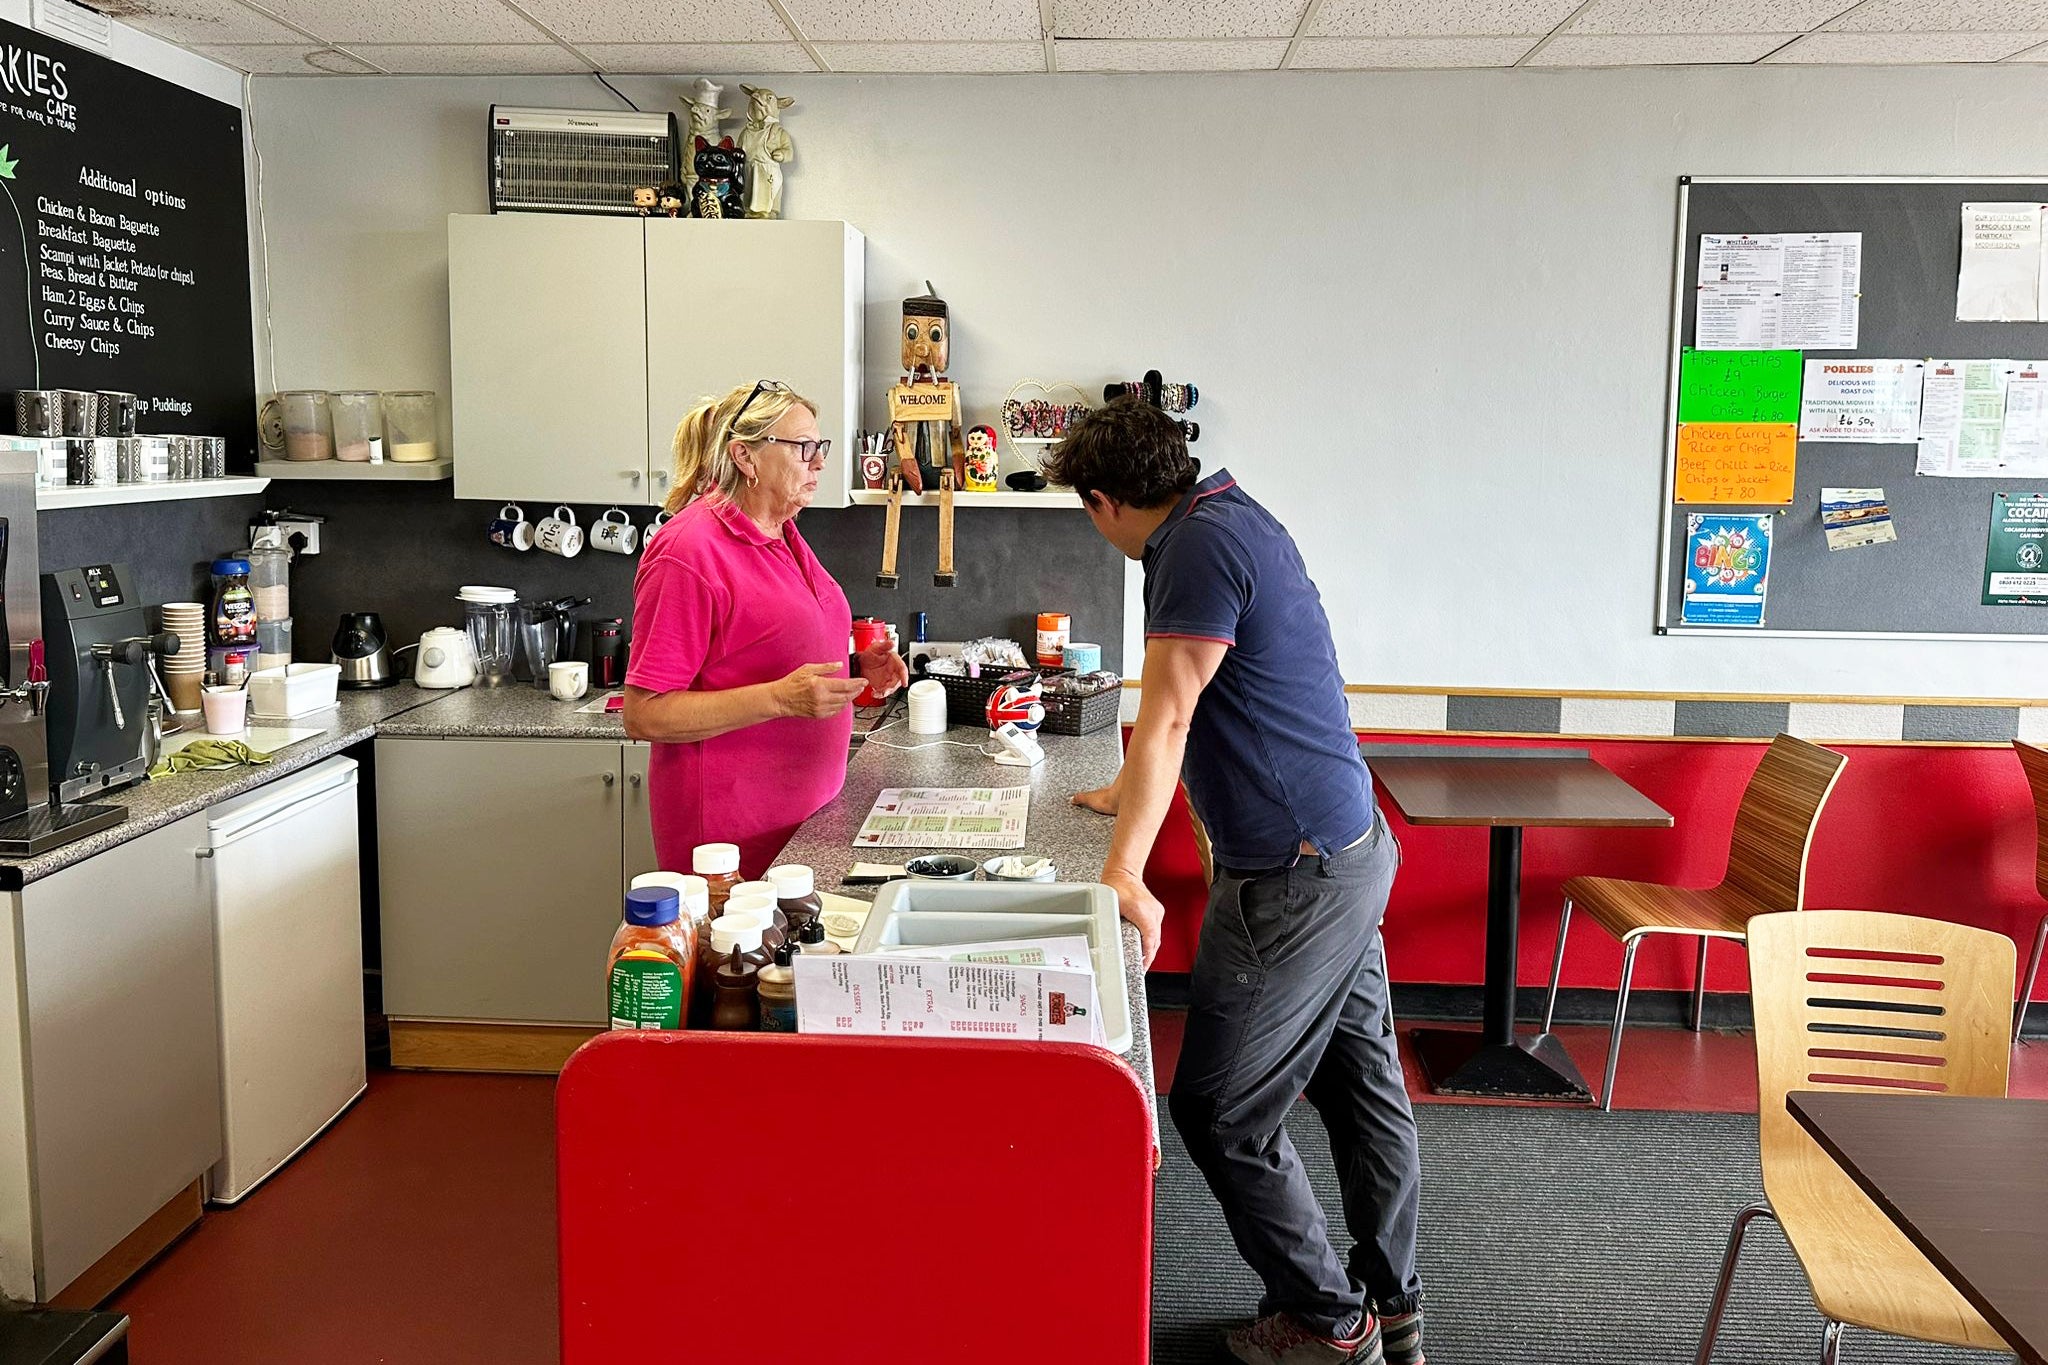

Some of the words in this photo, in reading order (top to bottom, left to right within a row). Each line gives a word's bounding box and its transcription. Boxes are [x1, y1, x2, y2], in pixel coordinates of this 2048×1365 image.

[11, 105, 26, 120] FOR
[27, 110, 46, 126] OVER
[56, 118, 76, 133] YEARS
[47, 99, 77, 120] CAFE
[79, 166, 136, 197] Additional
[145, 189, 186, 210] options
[38, 196, 74, 219] Chicken
[77, 206, 87, 223] &
[89, 208, 116, 228] Bacon
[120, 215, 160, 236] Baguette
[38, 220, 88, 245] Breakfast
[92, 231, 136, 253] Baguette
[40, 244, 75, 266] Scampi
[78, 254, 100, 269] with
[103, 255, 129, 273] Jacket
[131, 260, 156, 278] Potato
[157, 265, 169, 280] (or
[68, 267, 96, 286] Bread
[99, 273, 106, 288] &
[109, 274, 138, 292] Butter
[69, 290, 76, 305] 2
[79, 291, 106, 312] Eggs
[108, 296, 117, 311] &
[120, 297, 145, 317] Chips
[44, 309, 75, 331] Curry
[80, 313, 110, 332] Sauce
[113, 317, 124, 333] &
[127, 319, 155, 339] Chips
[45, 333, 86, 356] Cheesy
[91, 337, 120, 359] Chips
[1724, 368, 1741, 382] £9
[1824, 365, 1874, 374] PORKIES
[900, 395, 946, 405] WELCOME
[1689, 383, 1745, 397] Chicken
[1753, 385, 1789, 403] Burger
[153, 397, 192, 416] Puddings
[1839, 414, 1853, 426] £6
[1681, 426, 1730, 441] Chicken
[1735, 427, 1772, 445] Curry
[1688, 443, 1718, 454] Rice
[1680, 458, 1711, 473] Beef
[1715, 458, 1748, 470] Chilli
[1685, 473, 1718, 486] Chips
[1695, 545, 1761, 570] BINGO
[853, 984, 861, 1014] DESSERTS
